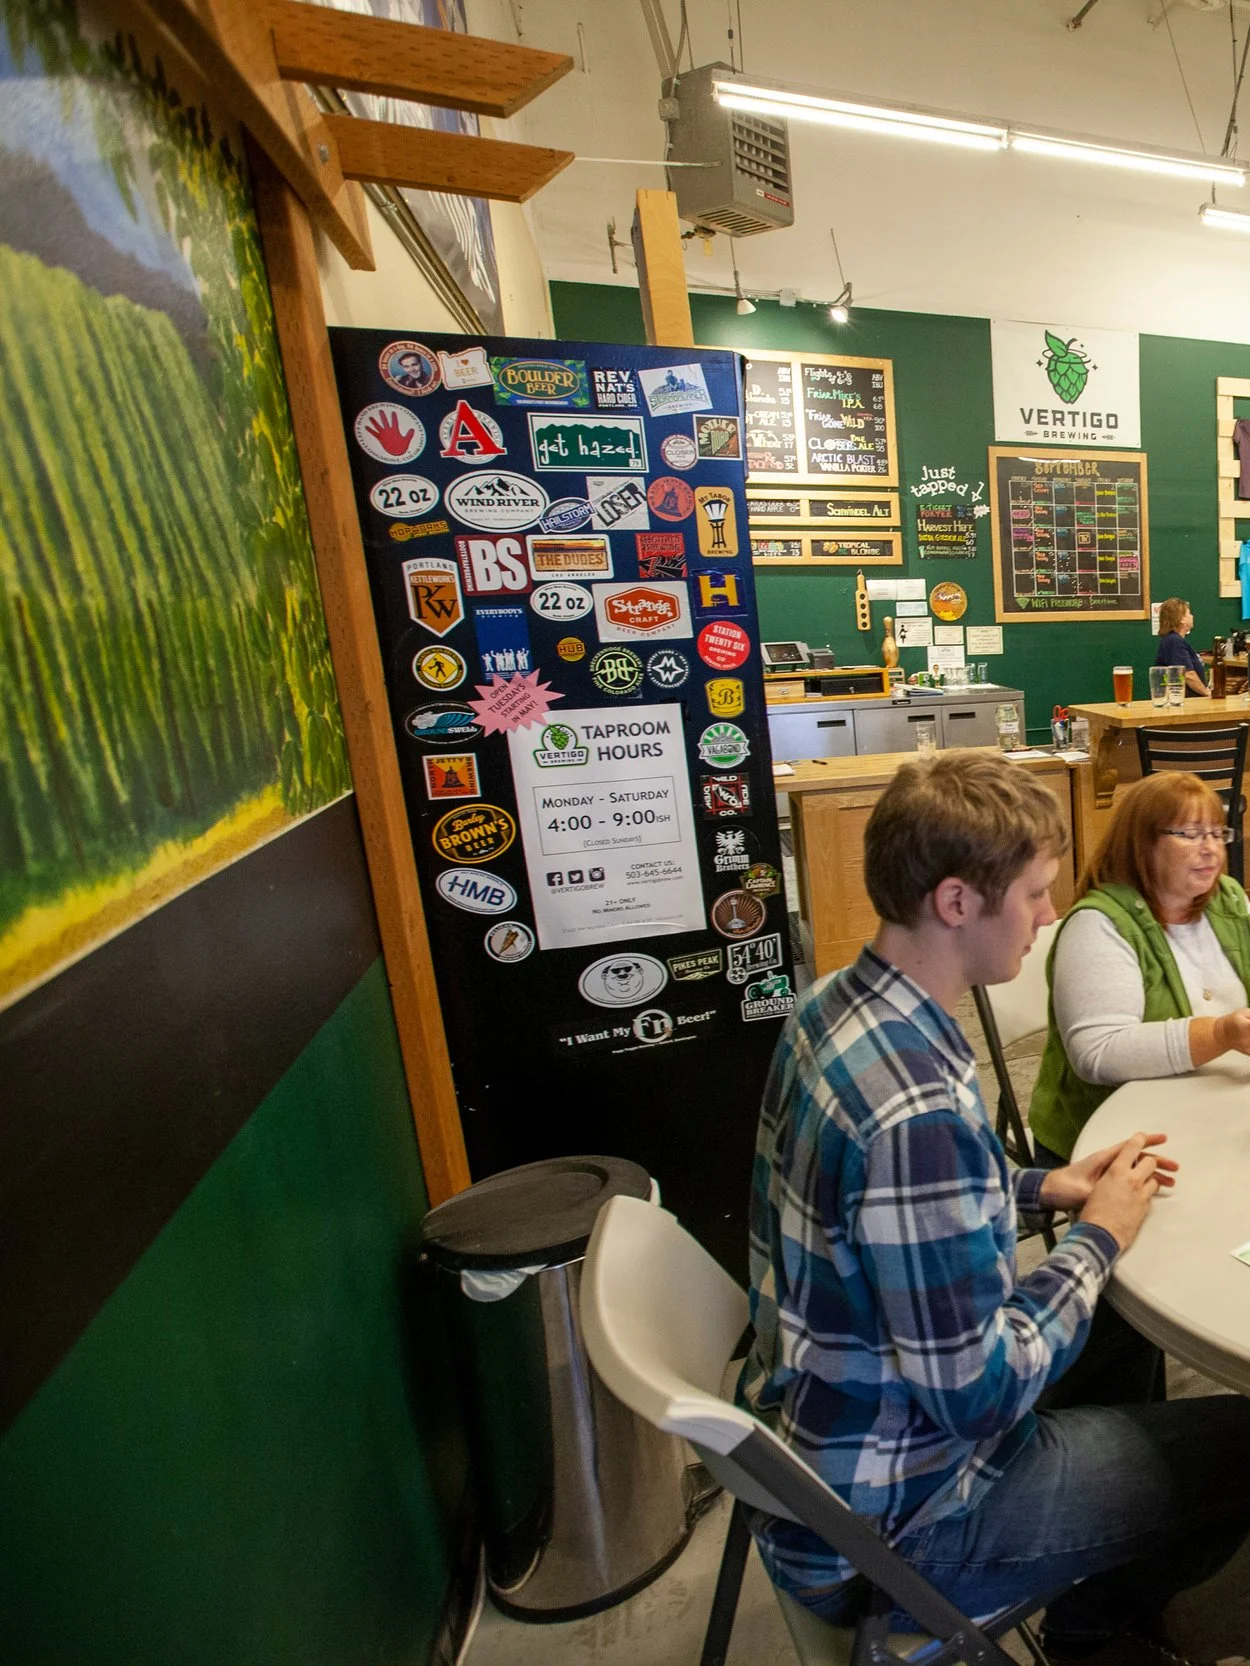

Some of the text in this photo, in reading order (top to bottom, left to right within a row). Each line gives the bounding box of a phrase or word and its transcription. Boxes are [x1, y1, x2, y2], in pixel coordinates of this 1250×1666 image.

[454, 367, 478, 376] BEER
[506, 369, 575, 388] BOULDER
[593, 371, 633, 382] REV.
[526, 382, 557, 395] BEER
[595, 383, 636, 392] NAT'S
[597, 393, 615, 404] HARD
[616, 393, 637, 404] CIDER
[1020, 408, 1118, 429] VERTIGO
[698, 419, 737, 445] MOTHER
[1044, 431, 1097, 440] BREWING
[539, 431, 639, 464] get hazed.
[811, 453, 876, 465] ARCTIC BLAST
[910, 480, 969, 498] tapped
[378, 487, 406, 508] 22
[456, 498, 540, 507] WIND RIVER
[598, 482, 647, 527] LOSER
[542, 502, 595, 531] HAILSTORM
[407, 563, 454, 571] PORTLAND
[468, 538, 528, 592] BS
[537, 554, 562, 566] THE
[410, 575, 456, 583] KETTLEWORKS
[698, 574, 740, 608] H
[539, 592, 562, 610] 22
[612, 599, 674, 616] Strange
[629, 616, 660, 624] CRAFT
[616, 624, 676, 637] BEER COMPANY
[713, 624, 742, 638] STATION
[559, 644, 584, 653] HUB
[704, 634, 745, 652] TWENTY SIX
[488, 682, 508, 700] OPEN
[488, 682, 527, 714] TUESDAYS
[718, 688, 734, 706] B
[500, 692, 532, 718] STARTING
[512, 700, 539, 724] IN MAY!
[581, 720, 671, 740] TAPROOM
[540, 750, 584, 760] VERTIGO
[598, 743, 663, 761] HOURS
[452, 813, 486, 832] Barley
[548, 816, 592, 832] 4:00
[439, 818, 510, 849] BROWN'S
[464, 838, 496, 852] BEER
[630, 861, 662, 870] CONTACT
[714, 854, 750, 864] Grimm
[716, 862, 750, 872] Brothers
[626, 866, 682, 880] 503-645-6644
[448, 876, 506, 906] HMB
[672, 956, 719, 972] PIKES PEAK
[745, 996, 794, 1010] GROUND
[746, 1004, 794, 1016] BREAKER
[576, 1031, 611, 1045] Want
[613, 1026, 630, 1040] My
